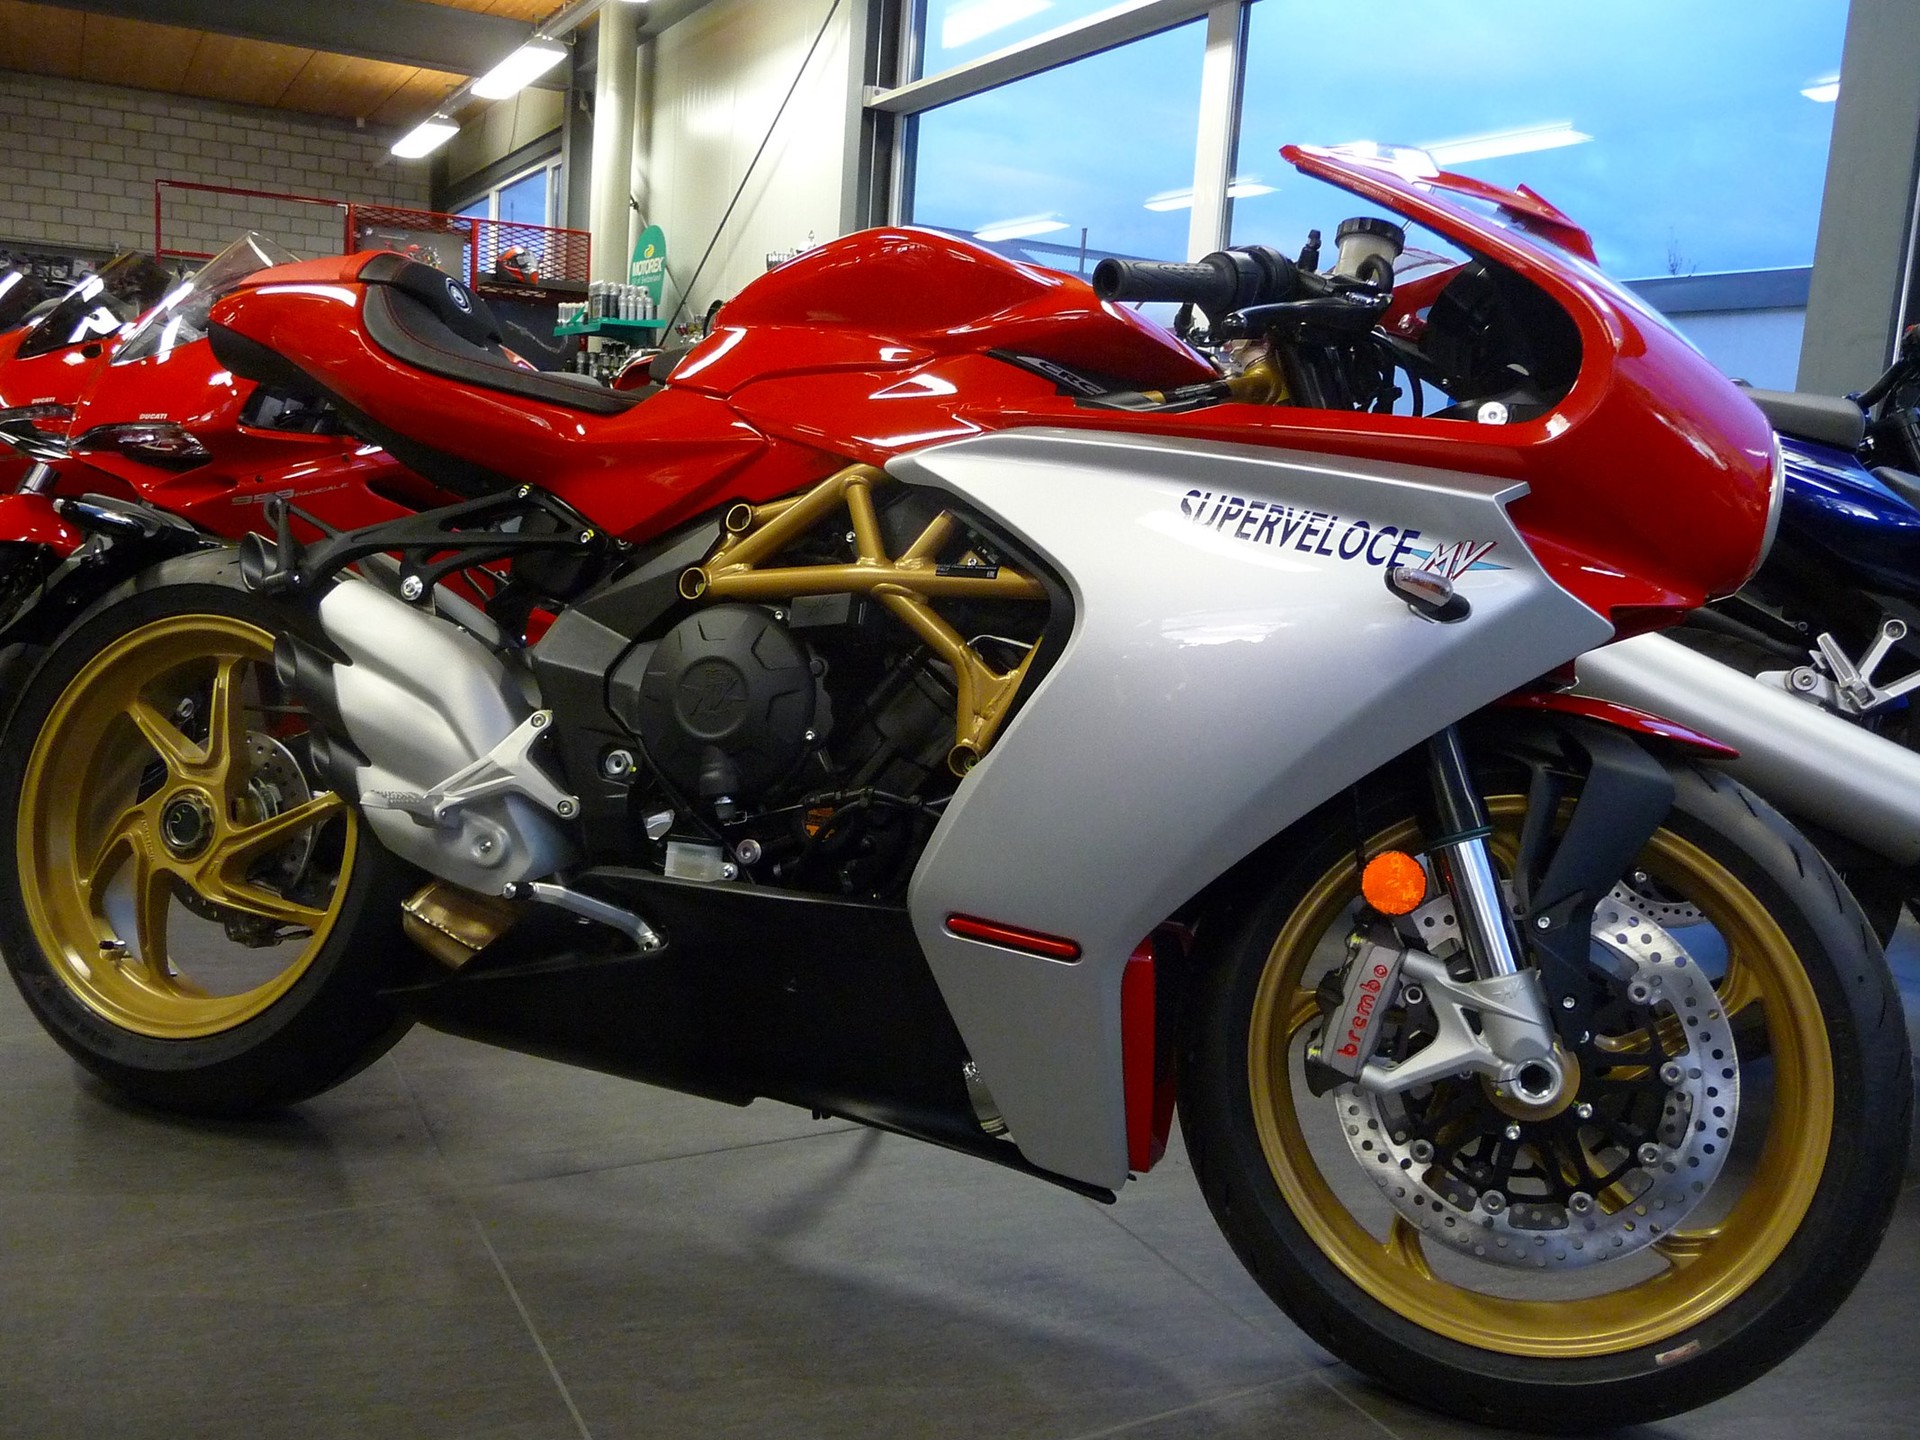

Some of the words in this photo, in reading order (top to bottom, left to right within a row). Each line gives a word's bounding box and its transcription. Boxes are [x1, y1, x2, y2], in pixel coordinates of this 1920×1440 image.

[631, 257, 665, 276] MOTOREX
[1180, 489, 1421, 567] SUPERVELOCE
[1417, 540, 1498, 581] MV
[1336, 964, 1388, 1057] brembo
